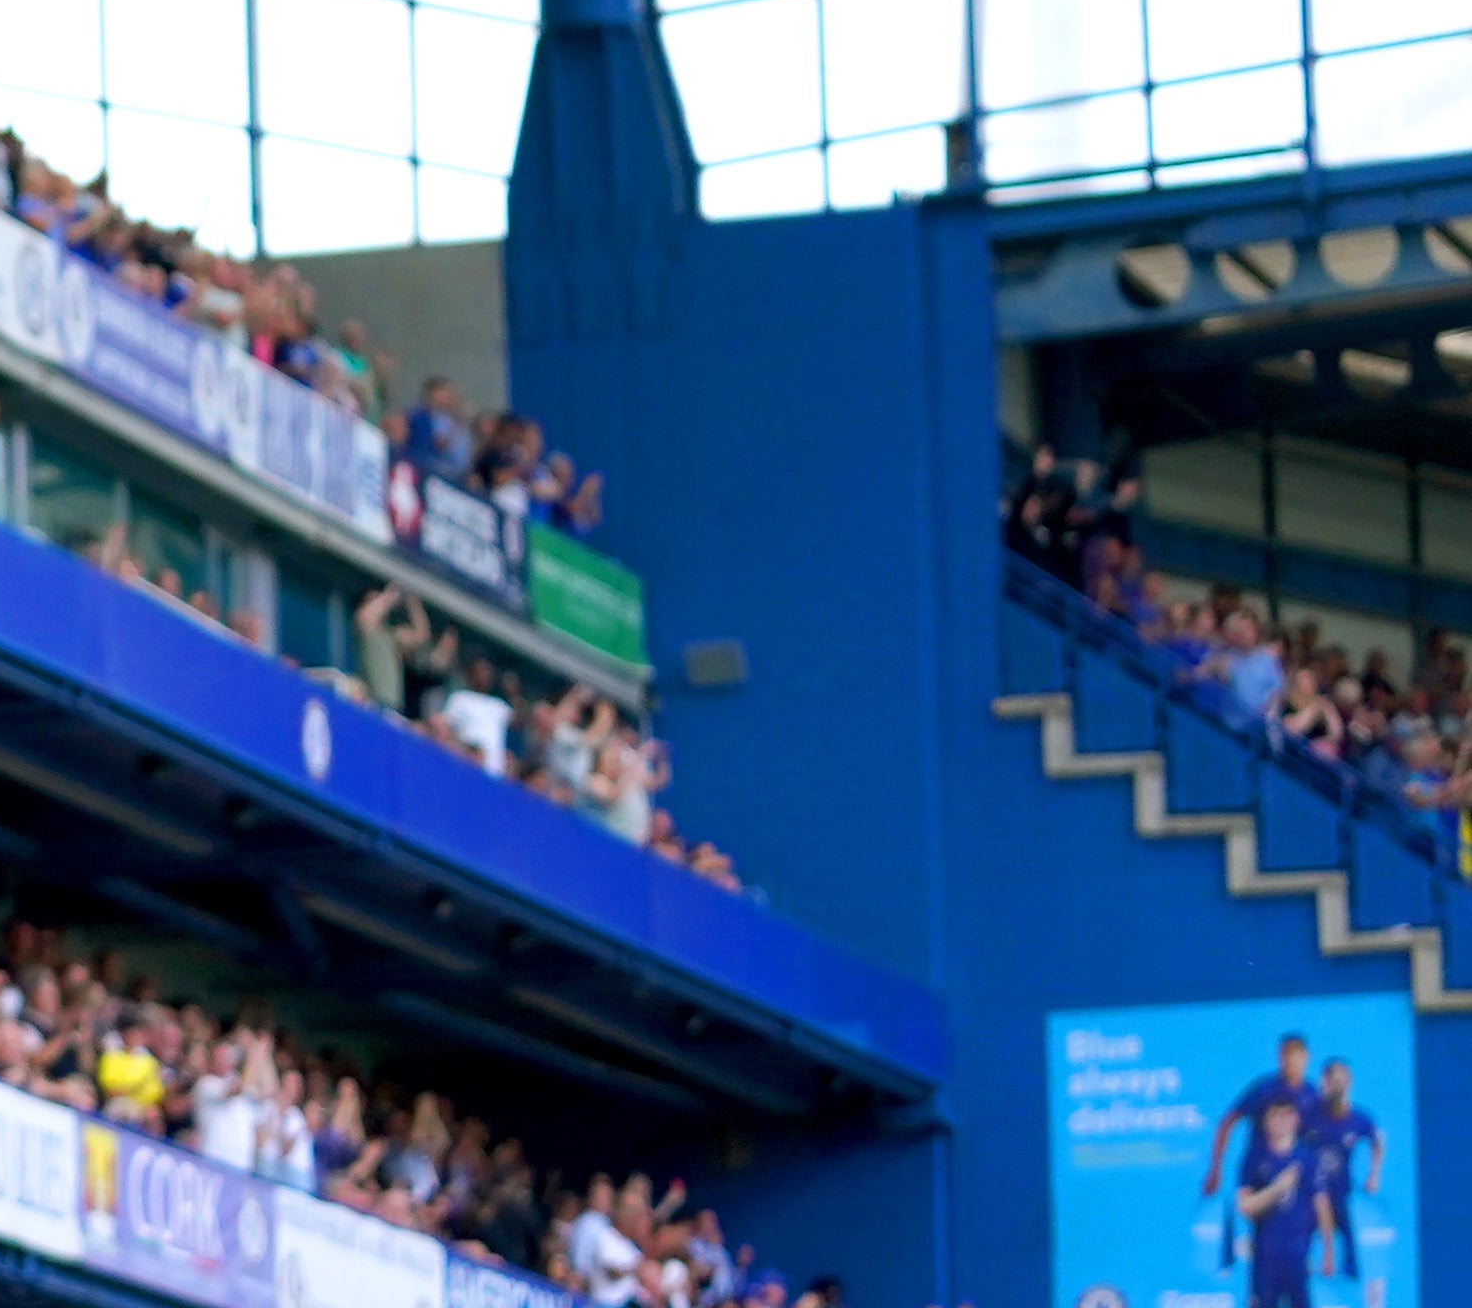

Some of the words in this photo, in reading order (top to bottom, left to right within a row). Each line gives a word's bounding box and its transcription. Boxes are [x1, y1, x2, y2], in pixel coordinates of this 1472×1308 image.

[1066, 1030, 1143, 1062] Blue
[1067, 1064, 1181, 1101] always
[129, 1145, 226, 1260] CORK
